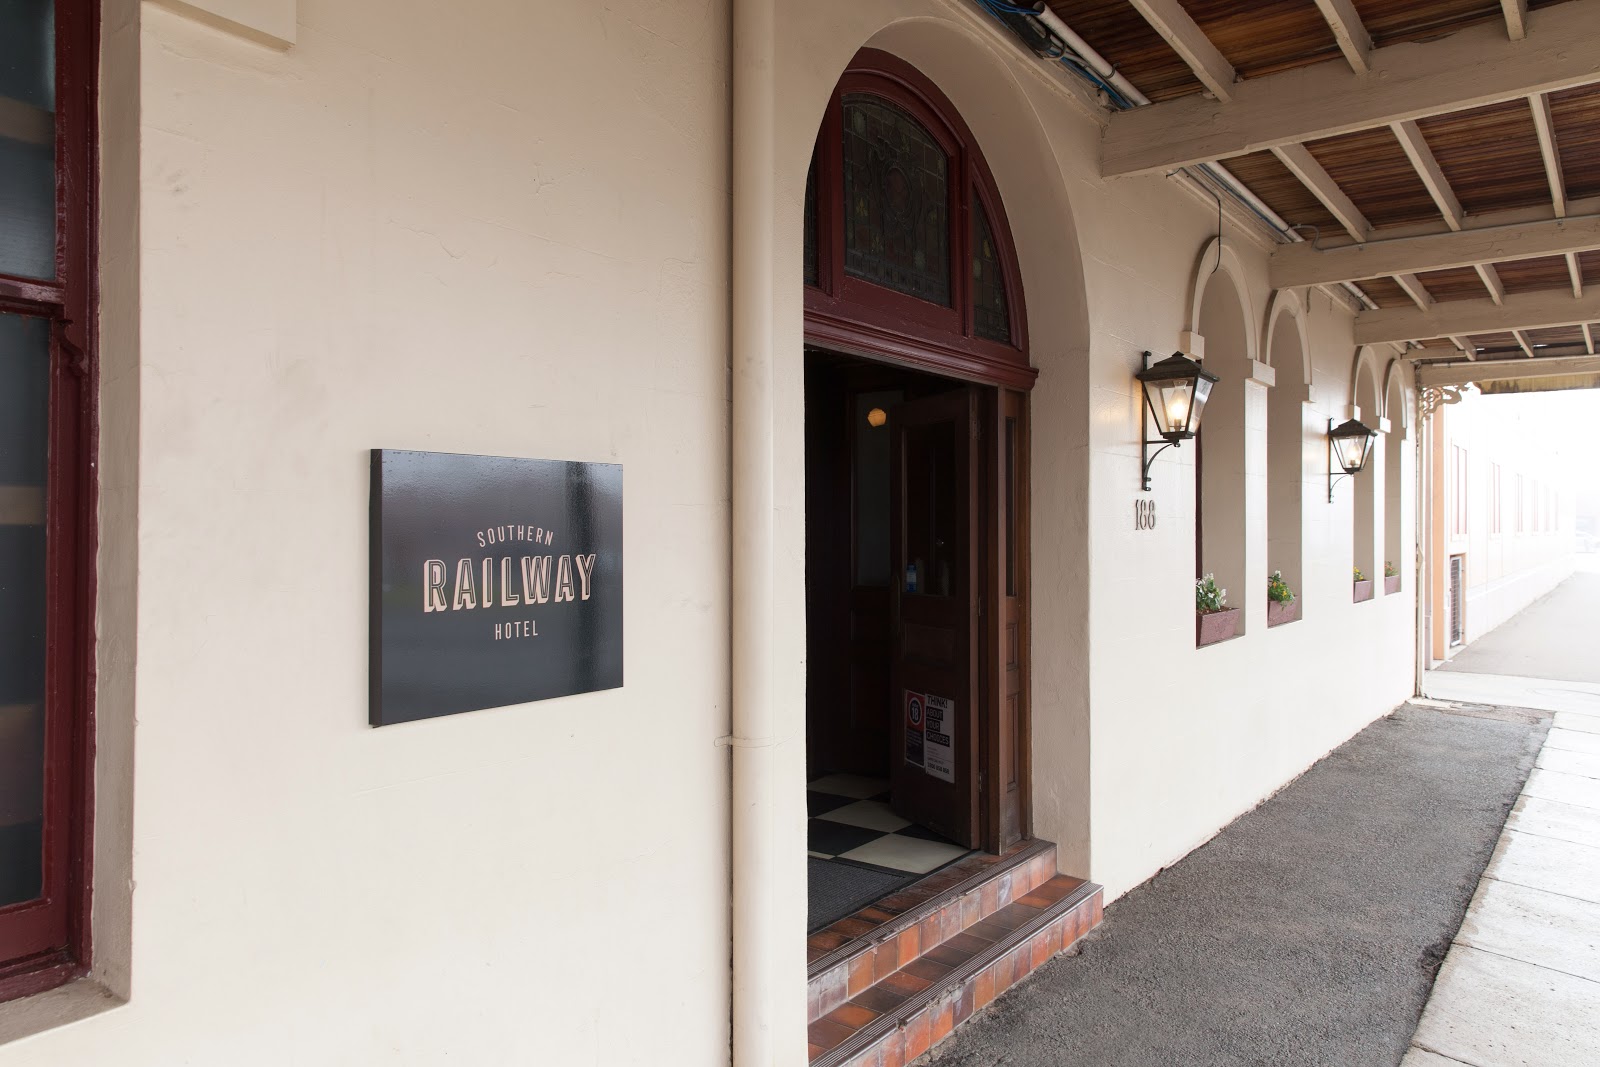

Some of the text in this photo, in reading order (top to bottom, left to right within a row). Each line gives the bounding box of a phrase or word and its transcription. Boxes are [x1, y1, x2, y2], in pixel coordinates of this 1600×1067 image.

[1135, 499, 1156, 531] 188
[477, 525, 554, 547] SOUTHERN
[423, 553, 596, 613] RAILWAY
[495, 620, 538, 640] HOTEL
[928, 695, 948, 708] THINK!
[911, 707, 919, 721] 18
[927, 708, 943, 720] ABOUT
[927, 720, 940, 732] YOUR
